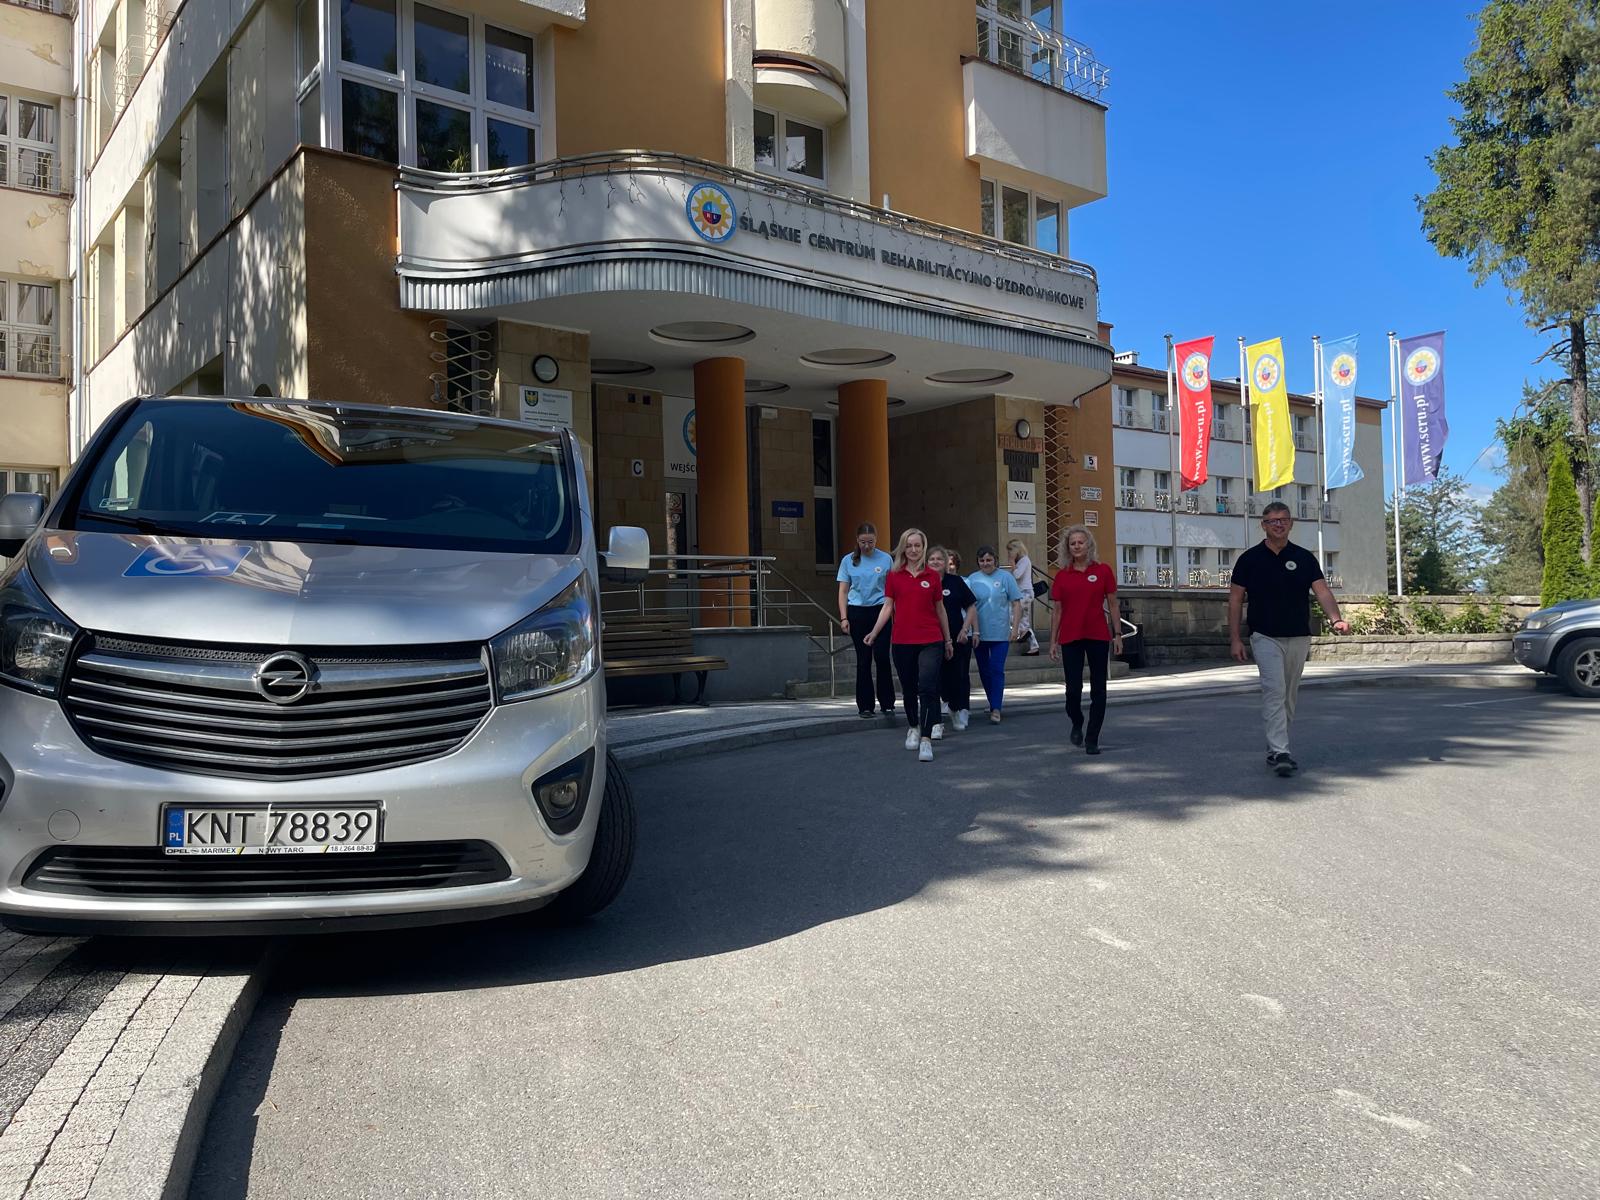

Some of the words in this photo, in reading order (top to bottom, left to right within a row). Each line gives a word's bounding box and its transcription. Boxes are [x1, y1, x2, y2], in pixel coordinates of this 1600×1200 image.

[738, 211, 802, 244] ŚLĄSKIE
[808, 232, 877, 261] CENTRUM
[1088, 456, 1094, 465] 5
[633, 461, 642, 475] C
[187, 812, 256, 844] KNT
[267, 811, 373, 843] 78839
[169, 832, 182, 841] PL
